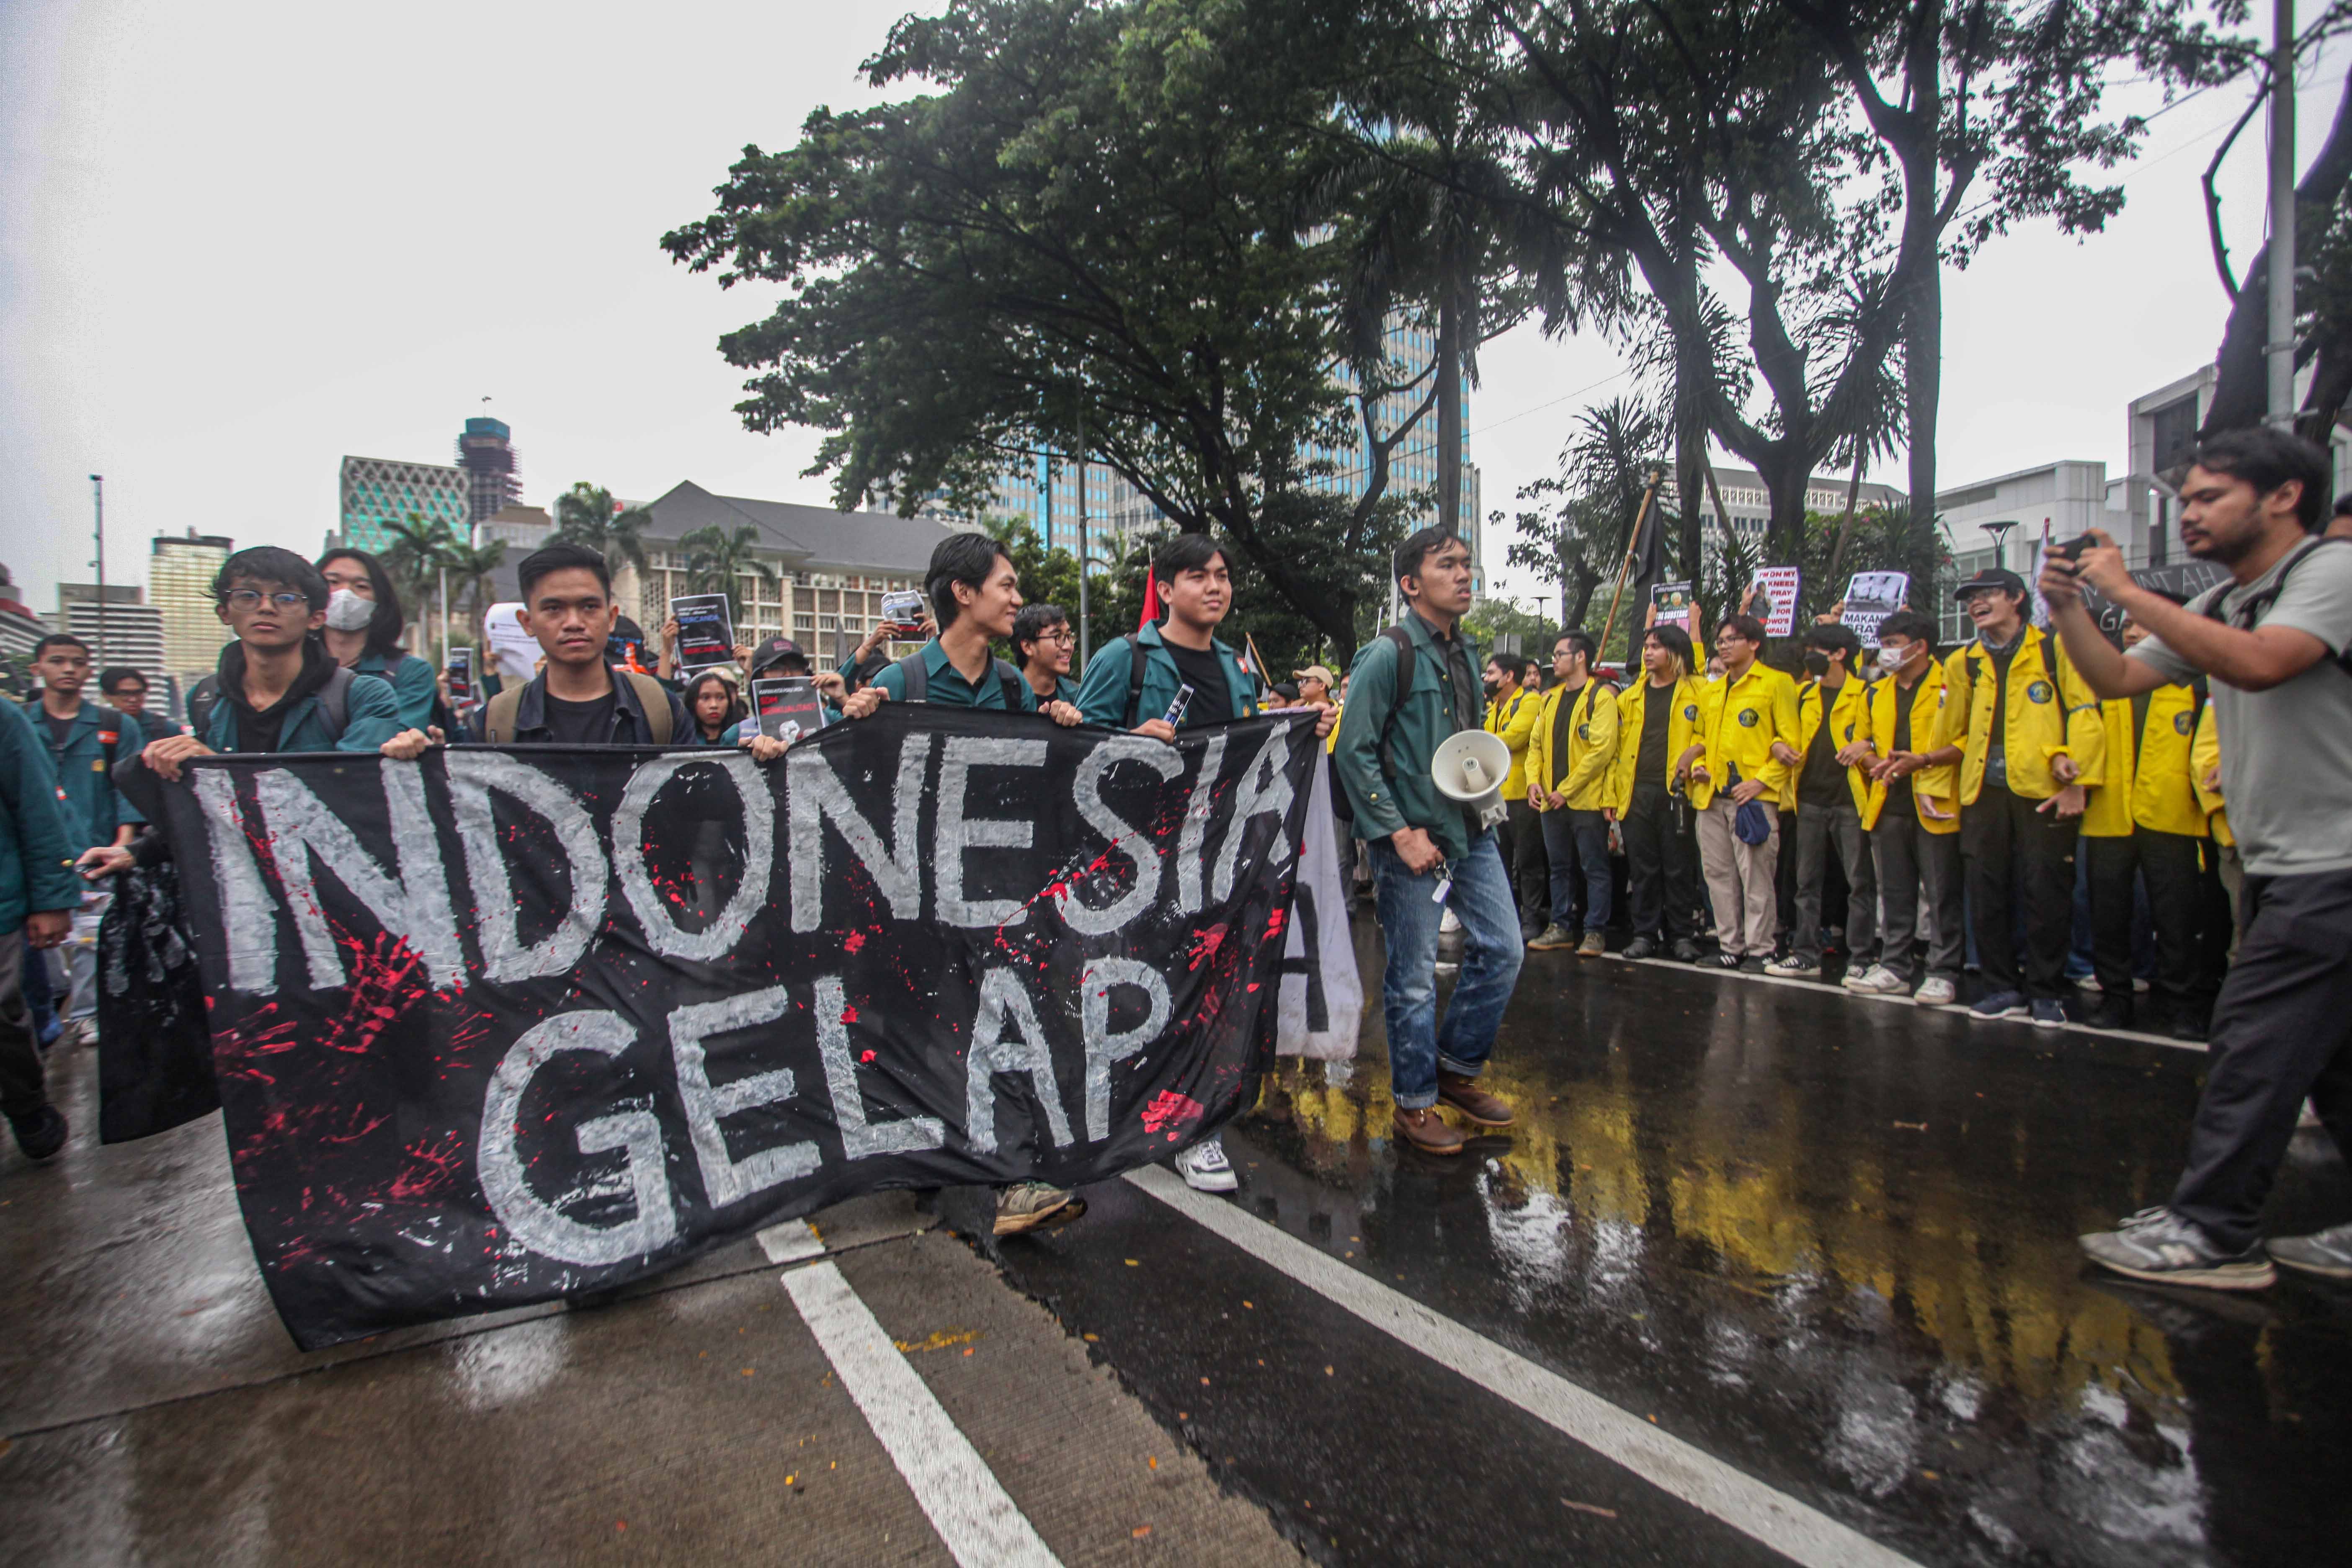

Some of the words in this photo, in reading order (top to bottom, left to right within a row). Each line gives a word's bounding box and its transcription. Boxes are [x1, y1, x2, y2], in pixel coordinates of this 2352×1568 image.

[1664, 609, 1689, 619] SUBSTANC
[1844, 614, 1883, 623] MAKAN
[193, 721, 1293, 996] INDONESIA
[477, 955, 1173, 1267] GELAP
